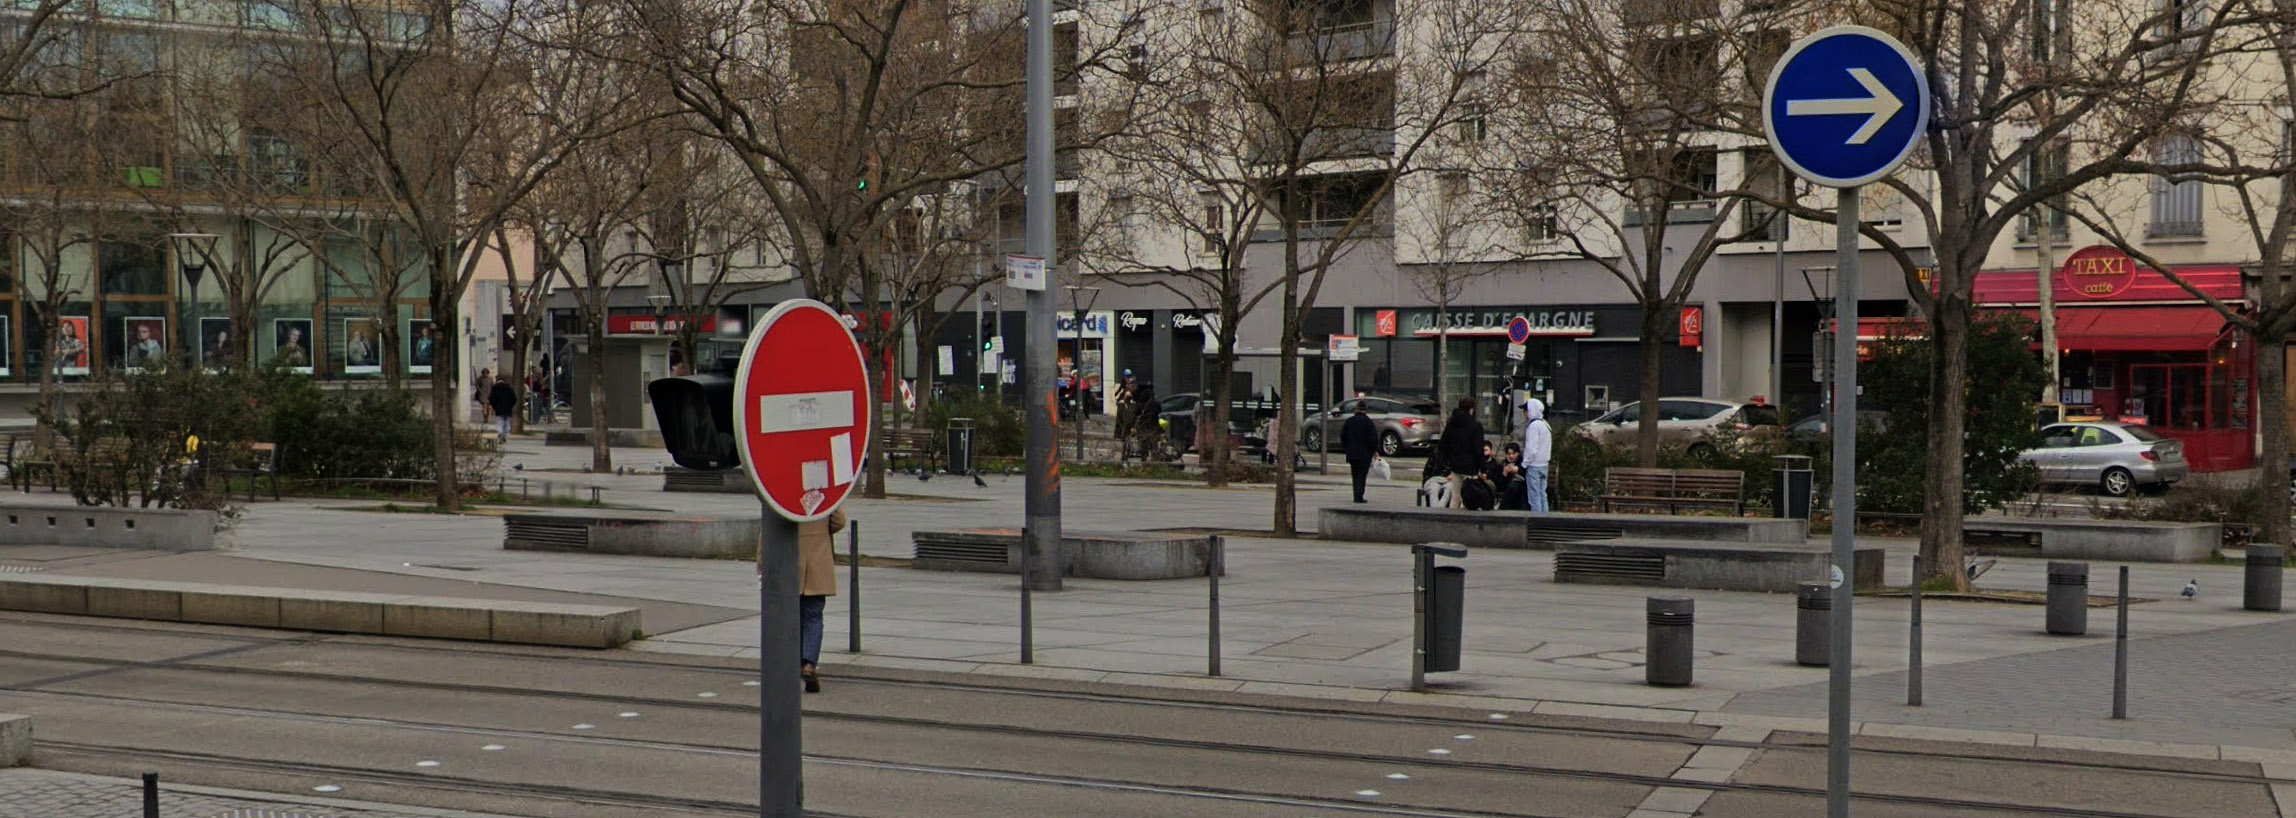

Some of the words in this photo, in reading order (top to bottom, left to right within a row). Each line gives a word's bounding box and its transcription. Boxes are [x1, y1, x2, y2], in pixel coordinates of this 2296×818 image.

[2073, 256, 2126, 275] TAXI
[1057, 314, 1097, 331] icard
[1483, 311, 1595, 329] D'EARGNE
